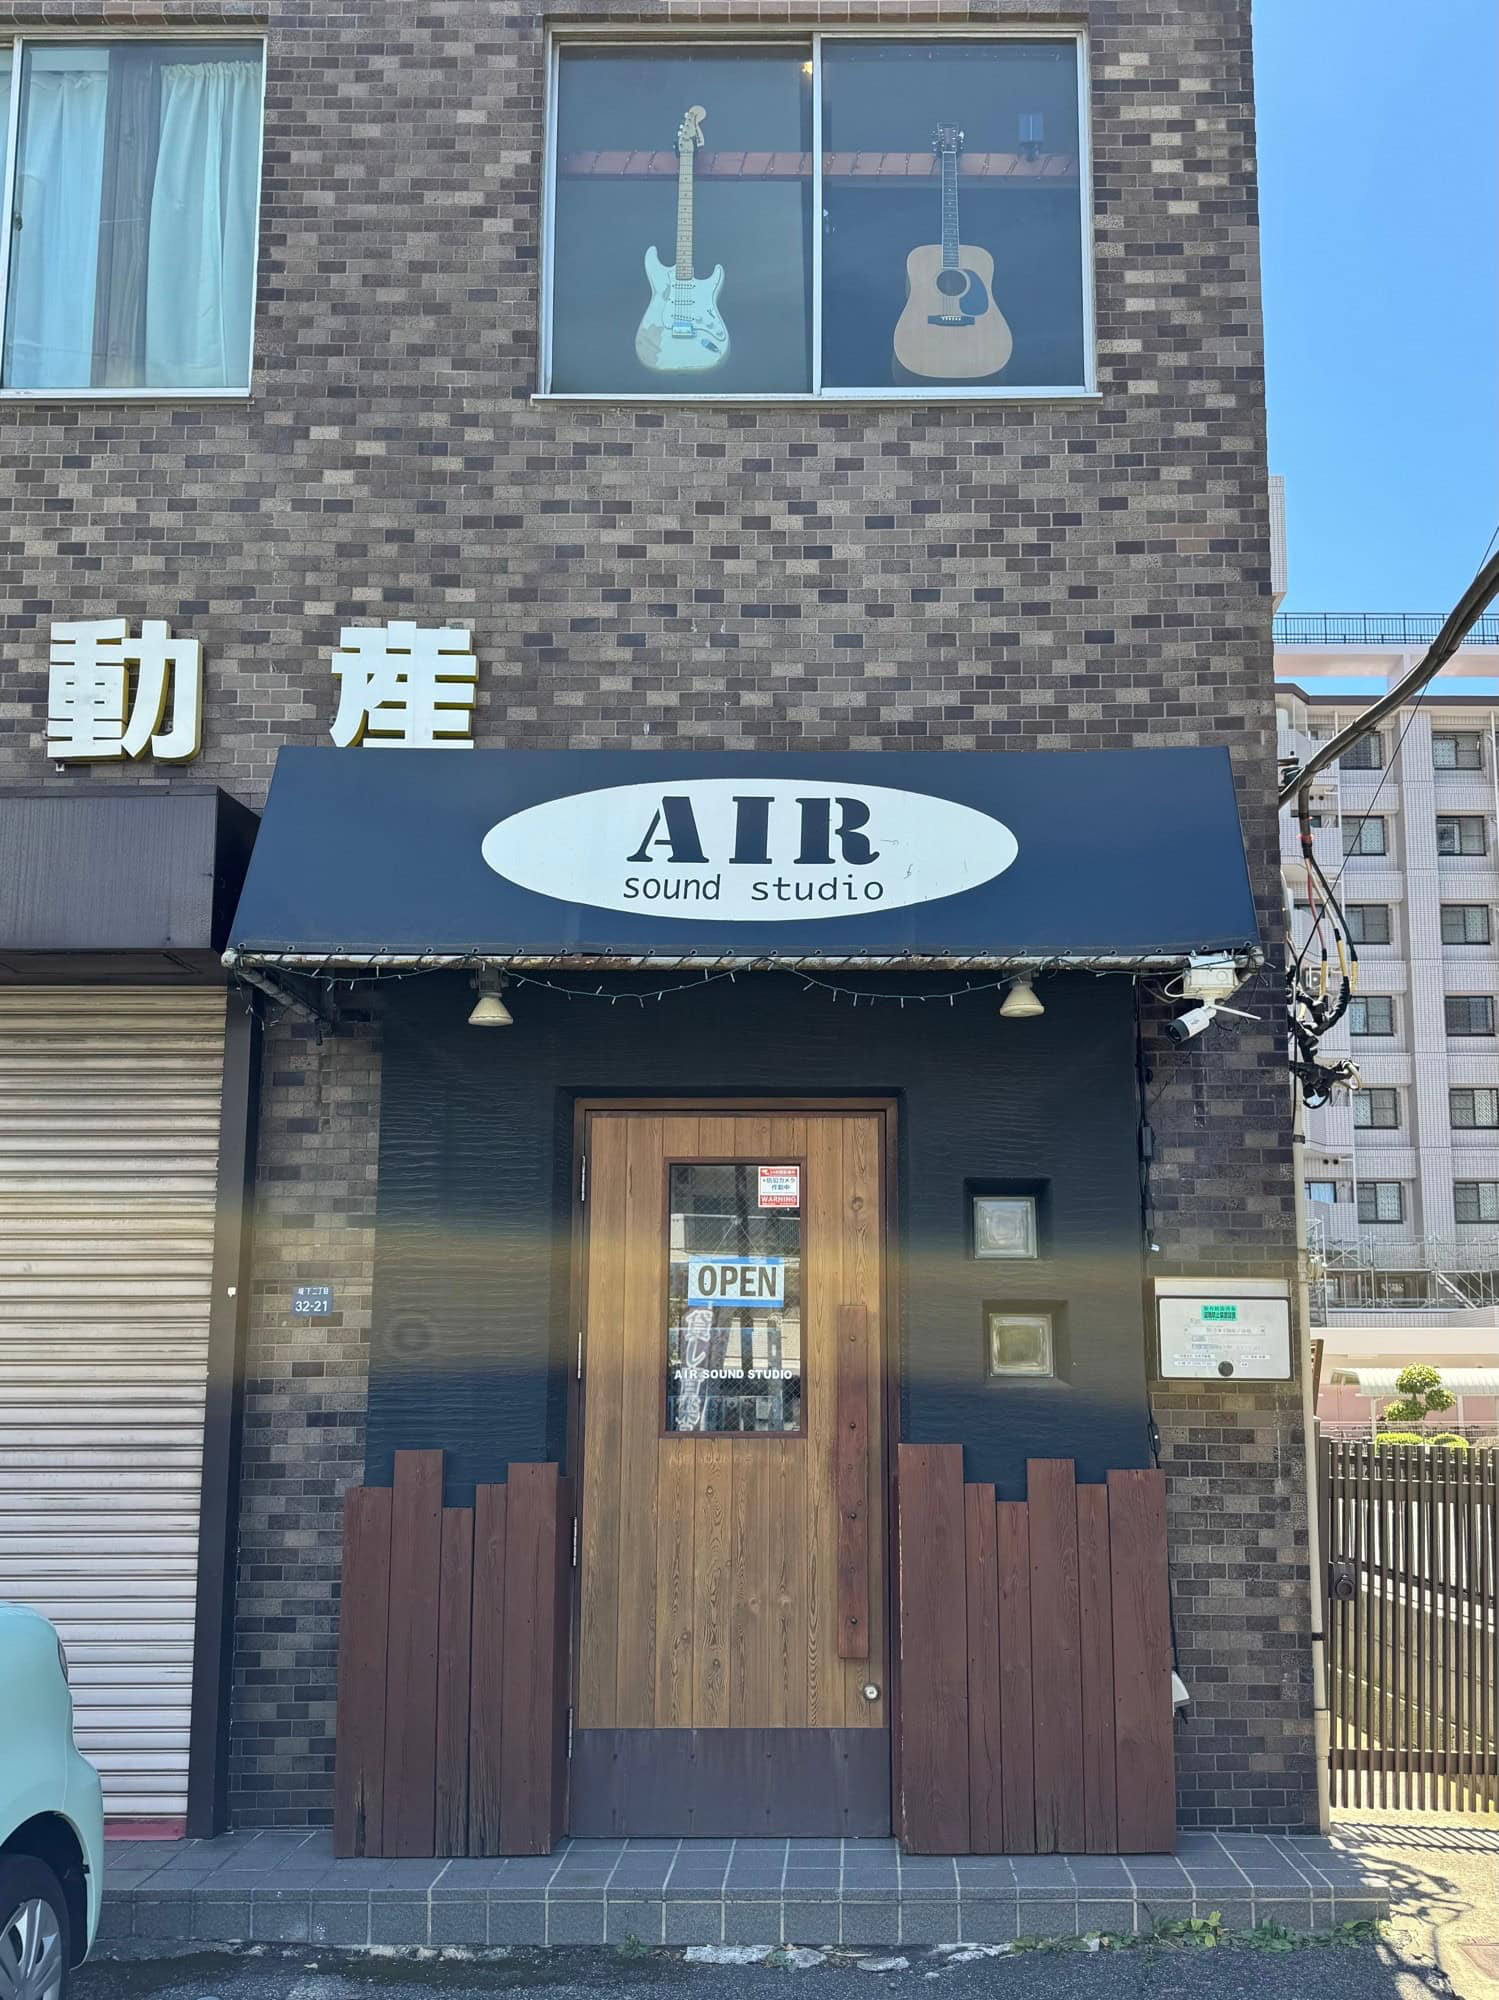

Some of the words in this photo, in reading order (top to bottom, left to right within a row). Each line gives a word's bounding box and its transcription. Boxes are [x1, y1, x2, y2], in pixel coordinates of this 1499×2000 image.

[626, 795, 880, 865] AIR
[623, 874, 721, 900] sound
[751, 874, 884, 901] studio
[698, 1265, 777, 1297] OPEN
[295, 1300, 328, 1312] 32-21
[674, 1369, 698, 1380] AIR
[703, 1369, 744, 1379] SOUND
[748, 1369, 793, 1379] STUDIO
